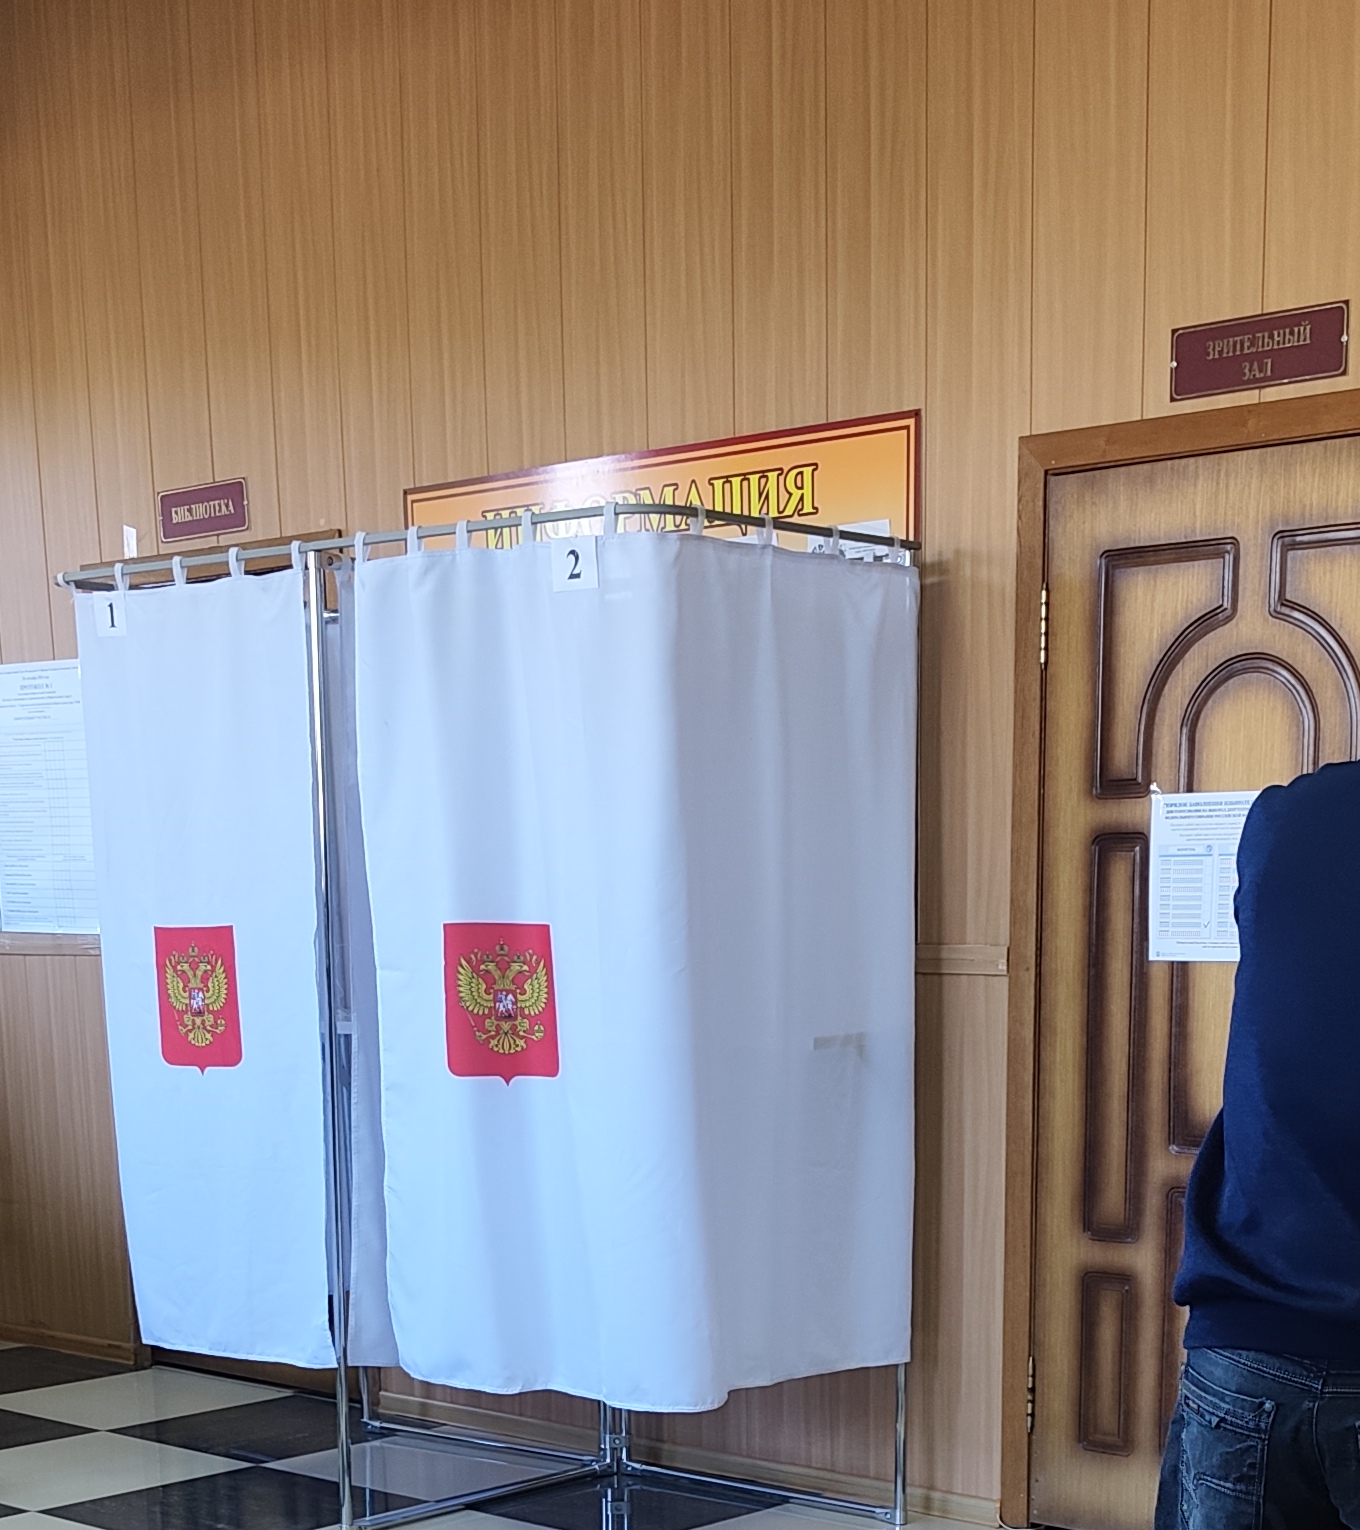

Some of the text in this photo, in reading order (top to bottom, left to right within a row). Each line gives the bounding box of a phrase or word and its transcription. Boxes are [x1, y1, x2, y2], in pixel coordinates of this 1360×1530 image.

[1206, 321, 1311, 360] ЗРИТЕЛЬНЫЙ
[1242, 358, 1272, 380] ЗАЛ
[171, 499, 235, 524] БИБЛИОТЕКА
[566, 548, 582, 581] 2
[107, 602, 117, 628] 1
